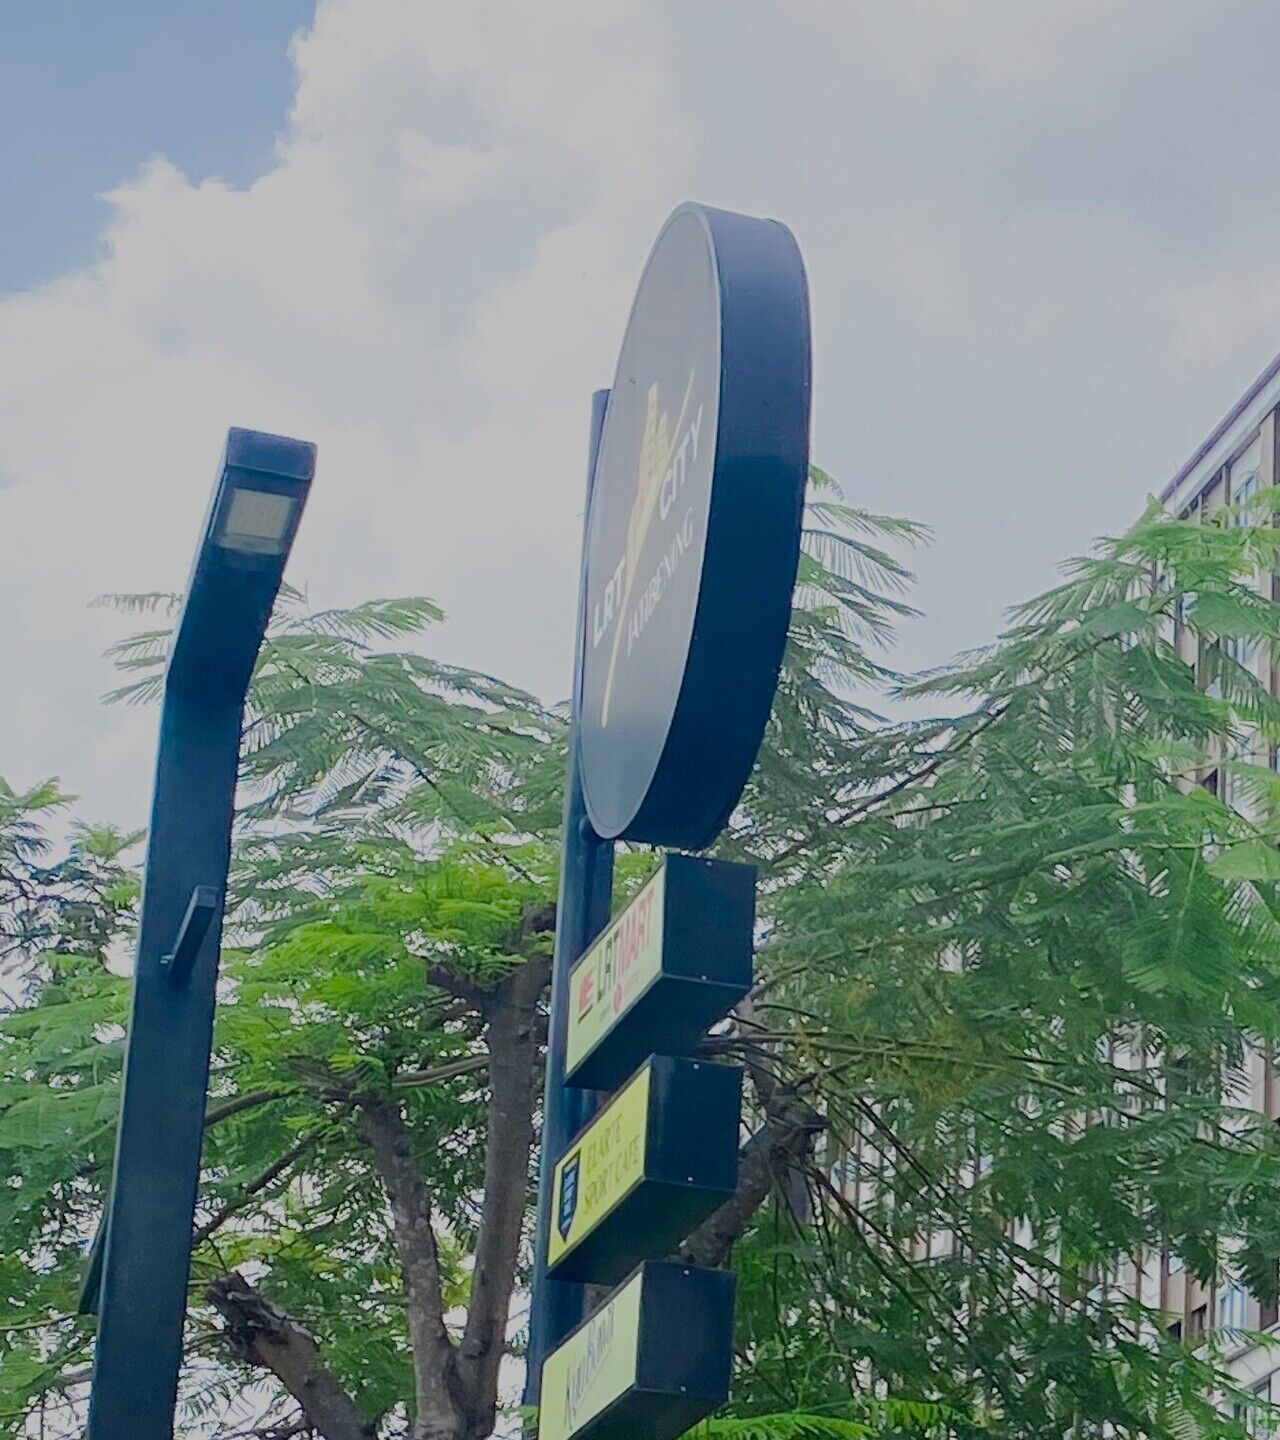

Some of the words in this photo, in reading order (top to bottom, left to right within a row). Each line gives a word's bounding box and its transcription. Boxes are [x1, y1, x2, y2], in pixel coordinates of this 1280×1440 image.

[593, 556, 626, 648] LRT
[660, 402, 704, 521] CITY
[627, 506, 694, 657] JATIBENING
[615, 1134, 641, 1183] CAFE
